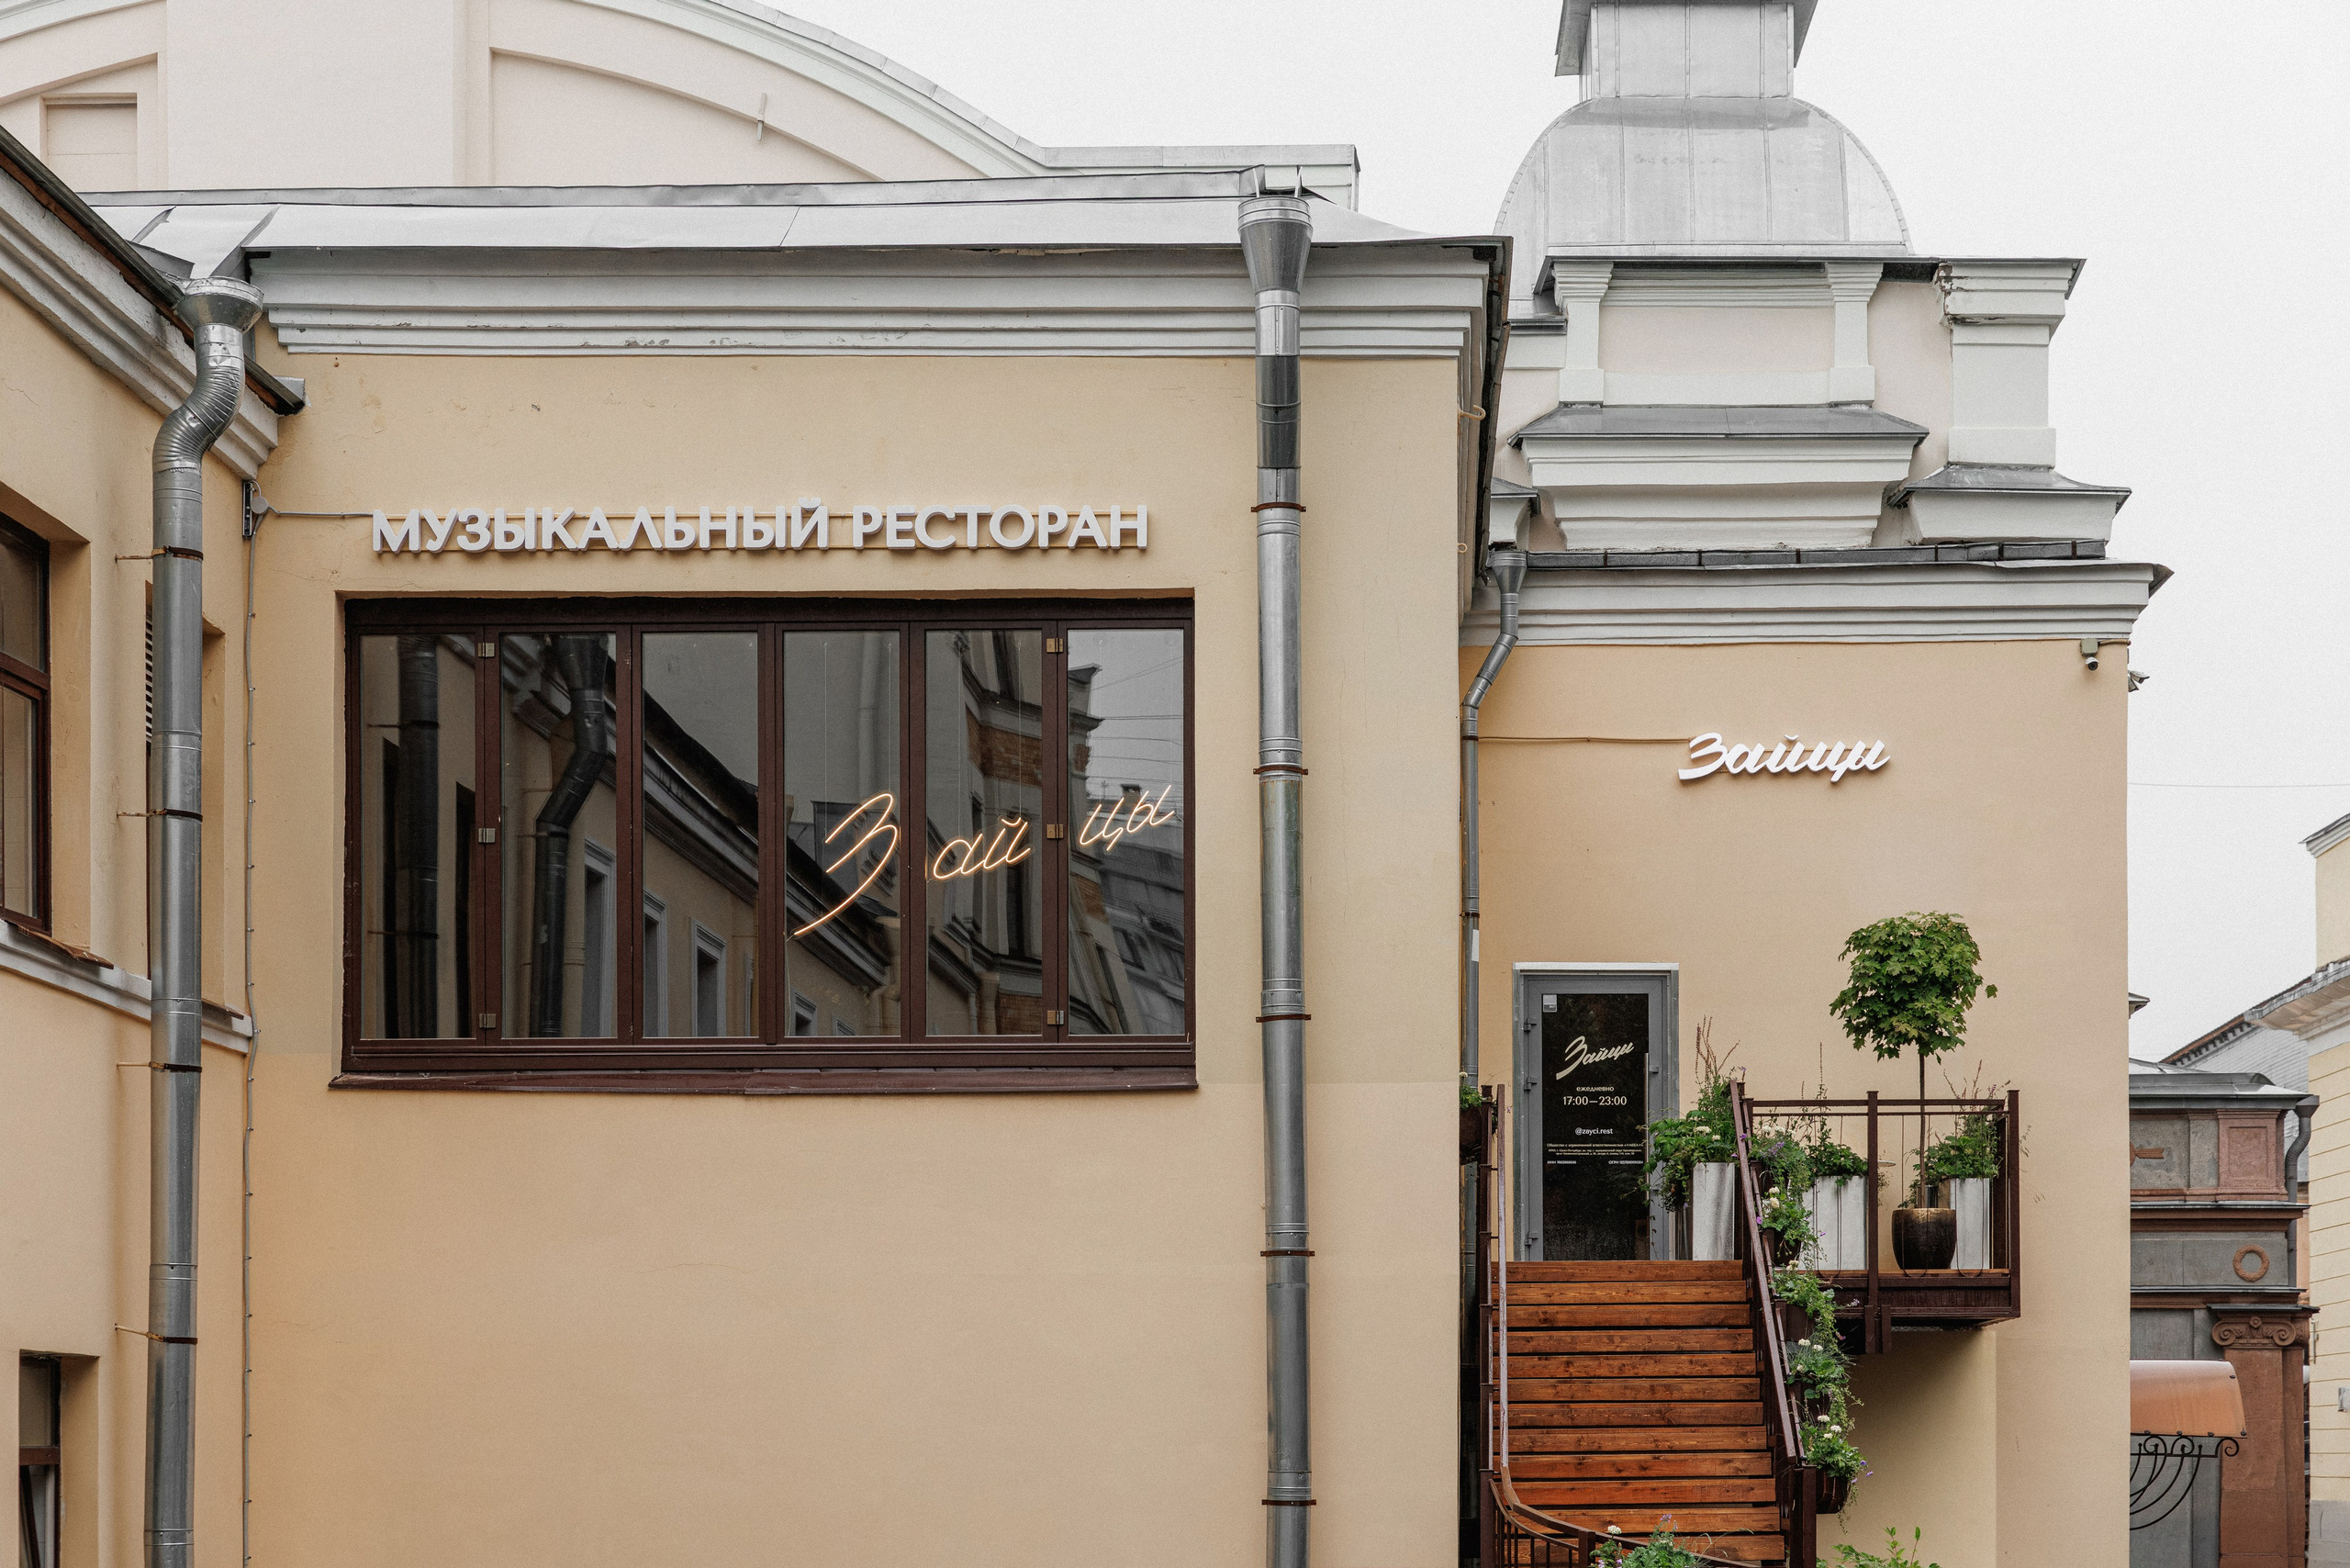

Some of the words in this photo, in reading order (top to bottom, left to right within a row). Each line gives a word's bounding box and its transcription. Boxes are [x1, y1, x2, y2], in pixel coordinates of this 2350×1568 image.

[372, 497, 829, 554] МУЗЫКАЛЬНЫЙ
[852, 503, 1149, 552] РЕСТОРАН
[1677, 732, 1891, 784] Зайцы
[1556, 1036, 1634, 1081] Зайцы
[1574, 1126, 1614, 1137] @zayci.rest
